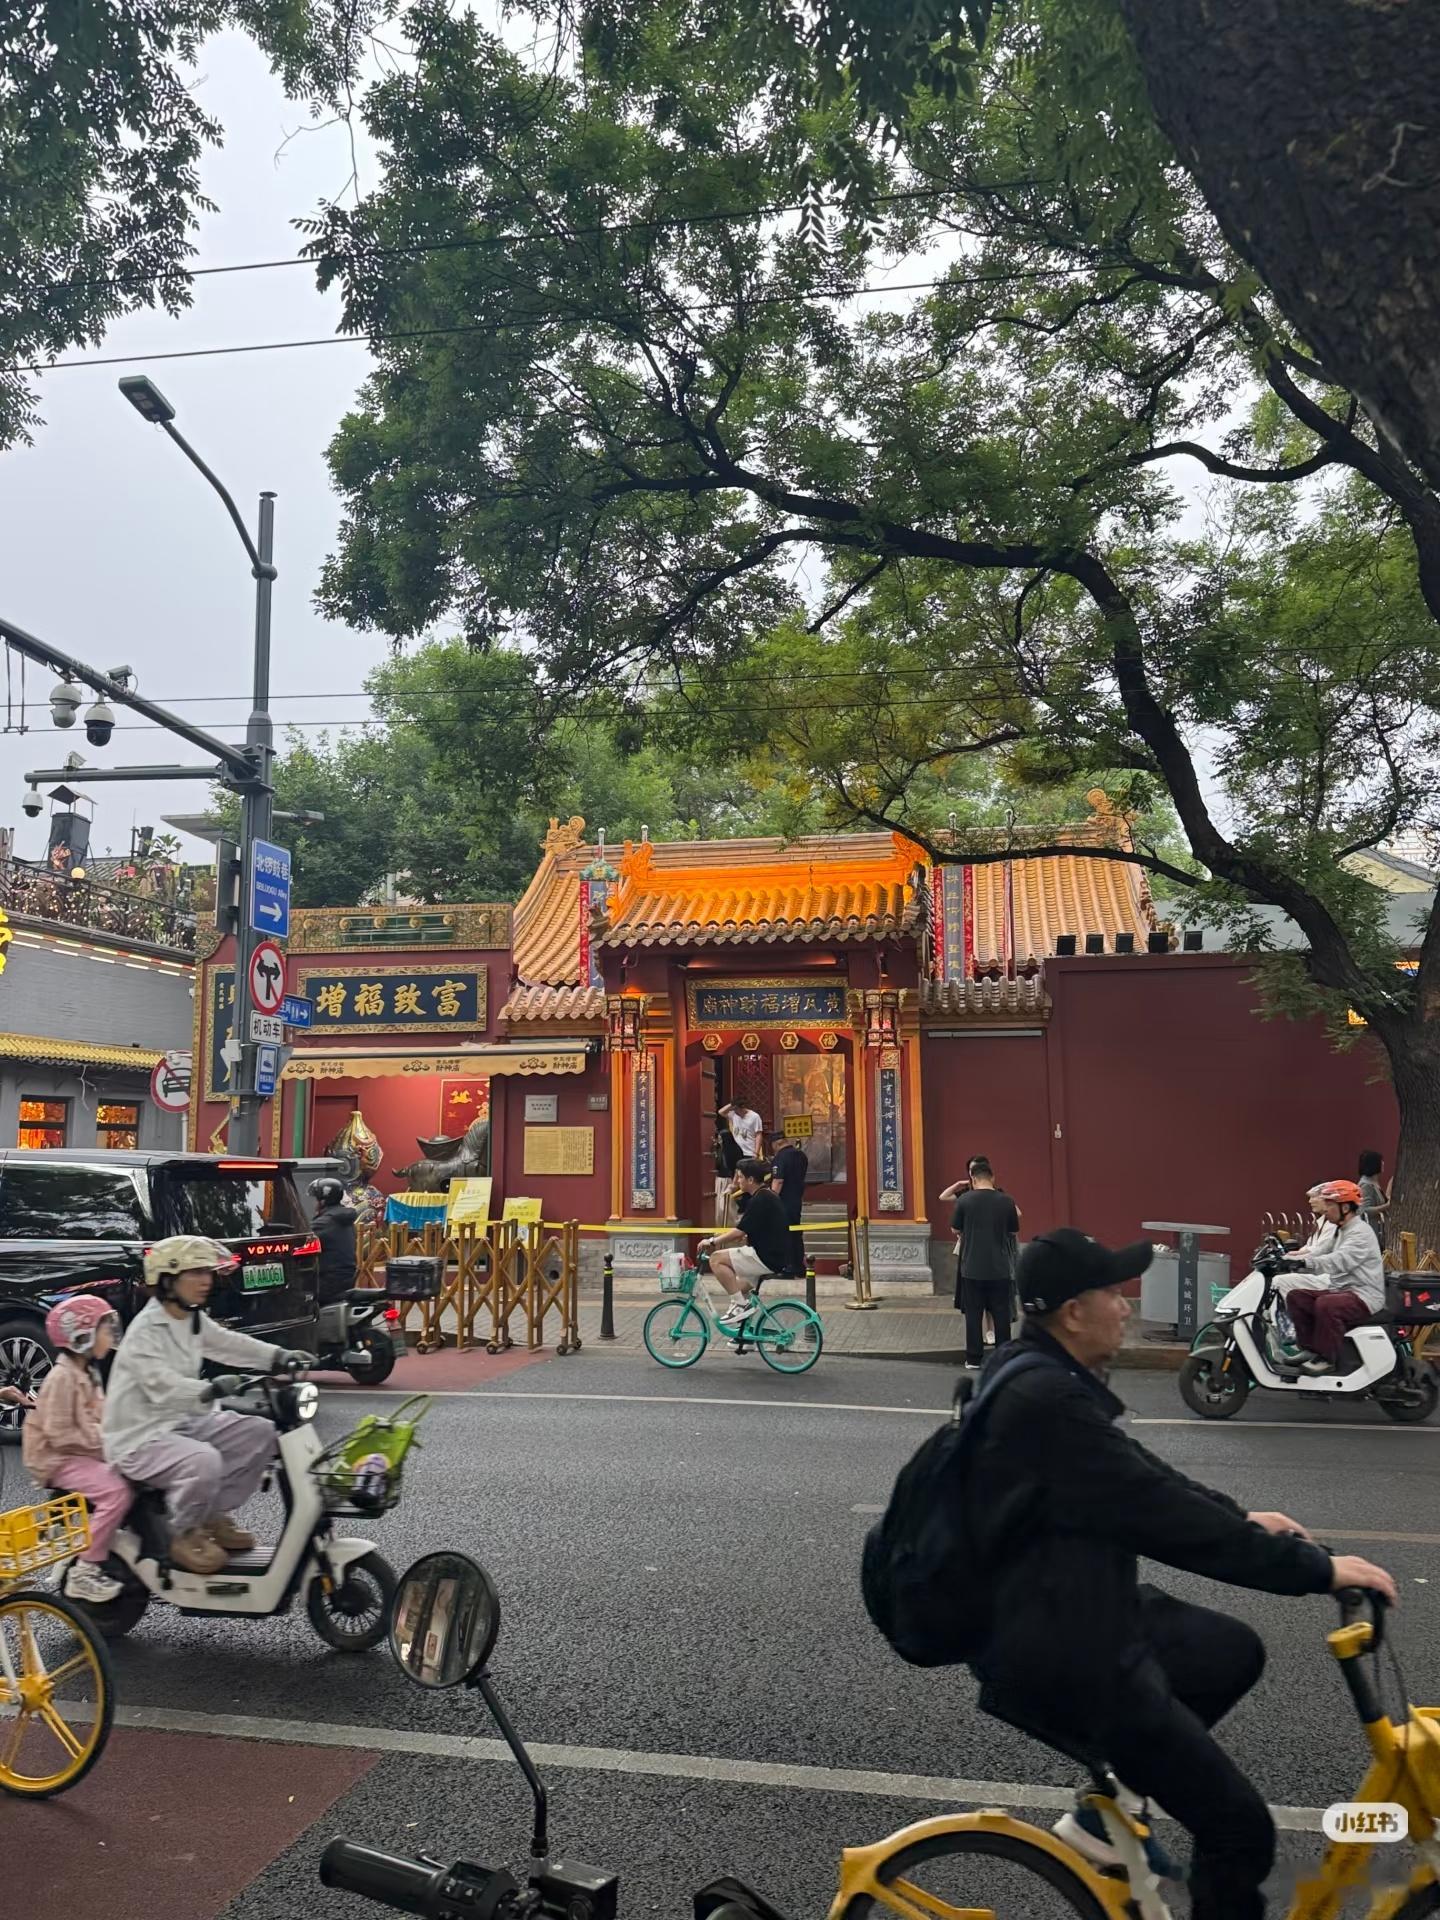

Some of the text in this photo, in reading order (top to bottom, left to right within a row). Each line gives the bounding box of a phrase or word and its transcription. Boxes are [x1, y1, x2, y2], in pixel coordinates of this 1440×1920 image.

[255, 854, 289, 880] 北锣鼓巷
[316, 979, 467, 1018] 增福致富
[253, 1019, 281, 1038] 机动车
[248, 1244, 289, 1254] VOYAH
[1183, 1277, 1193, 1325] 东城环卫
